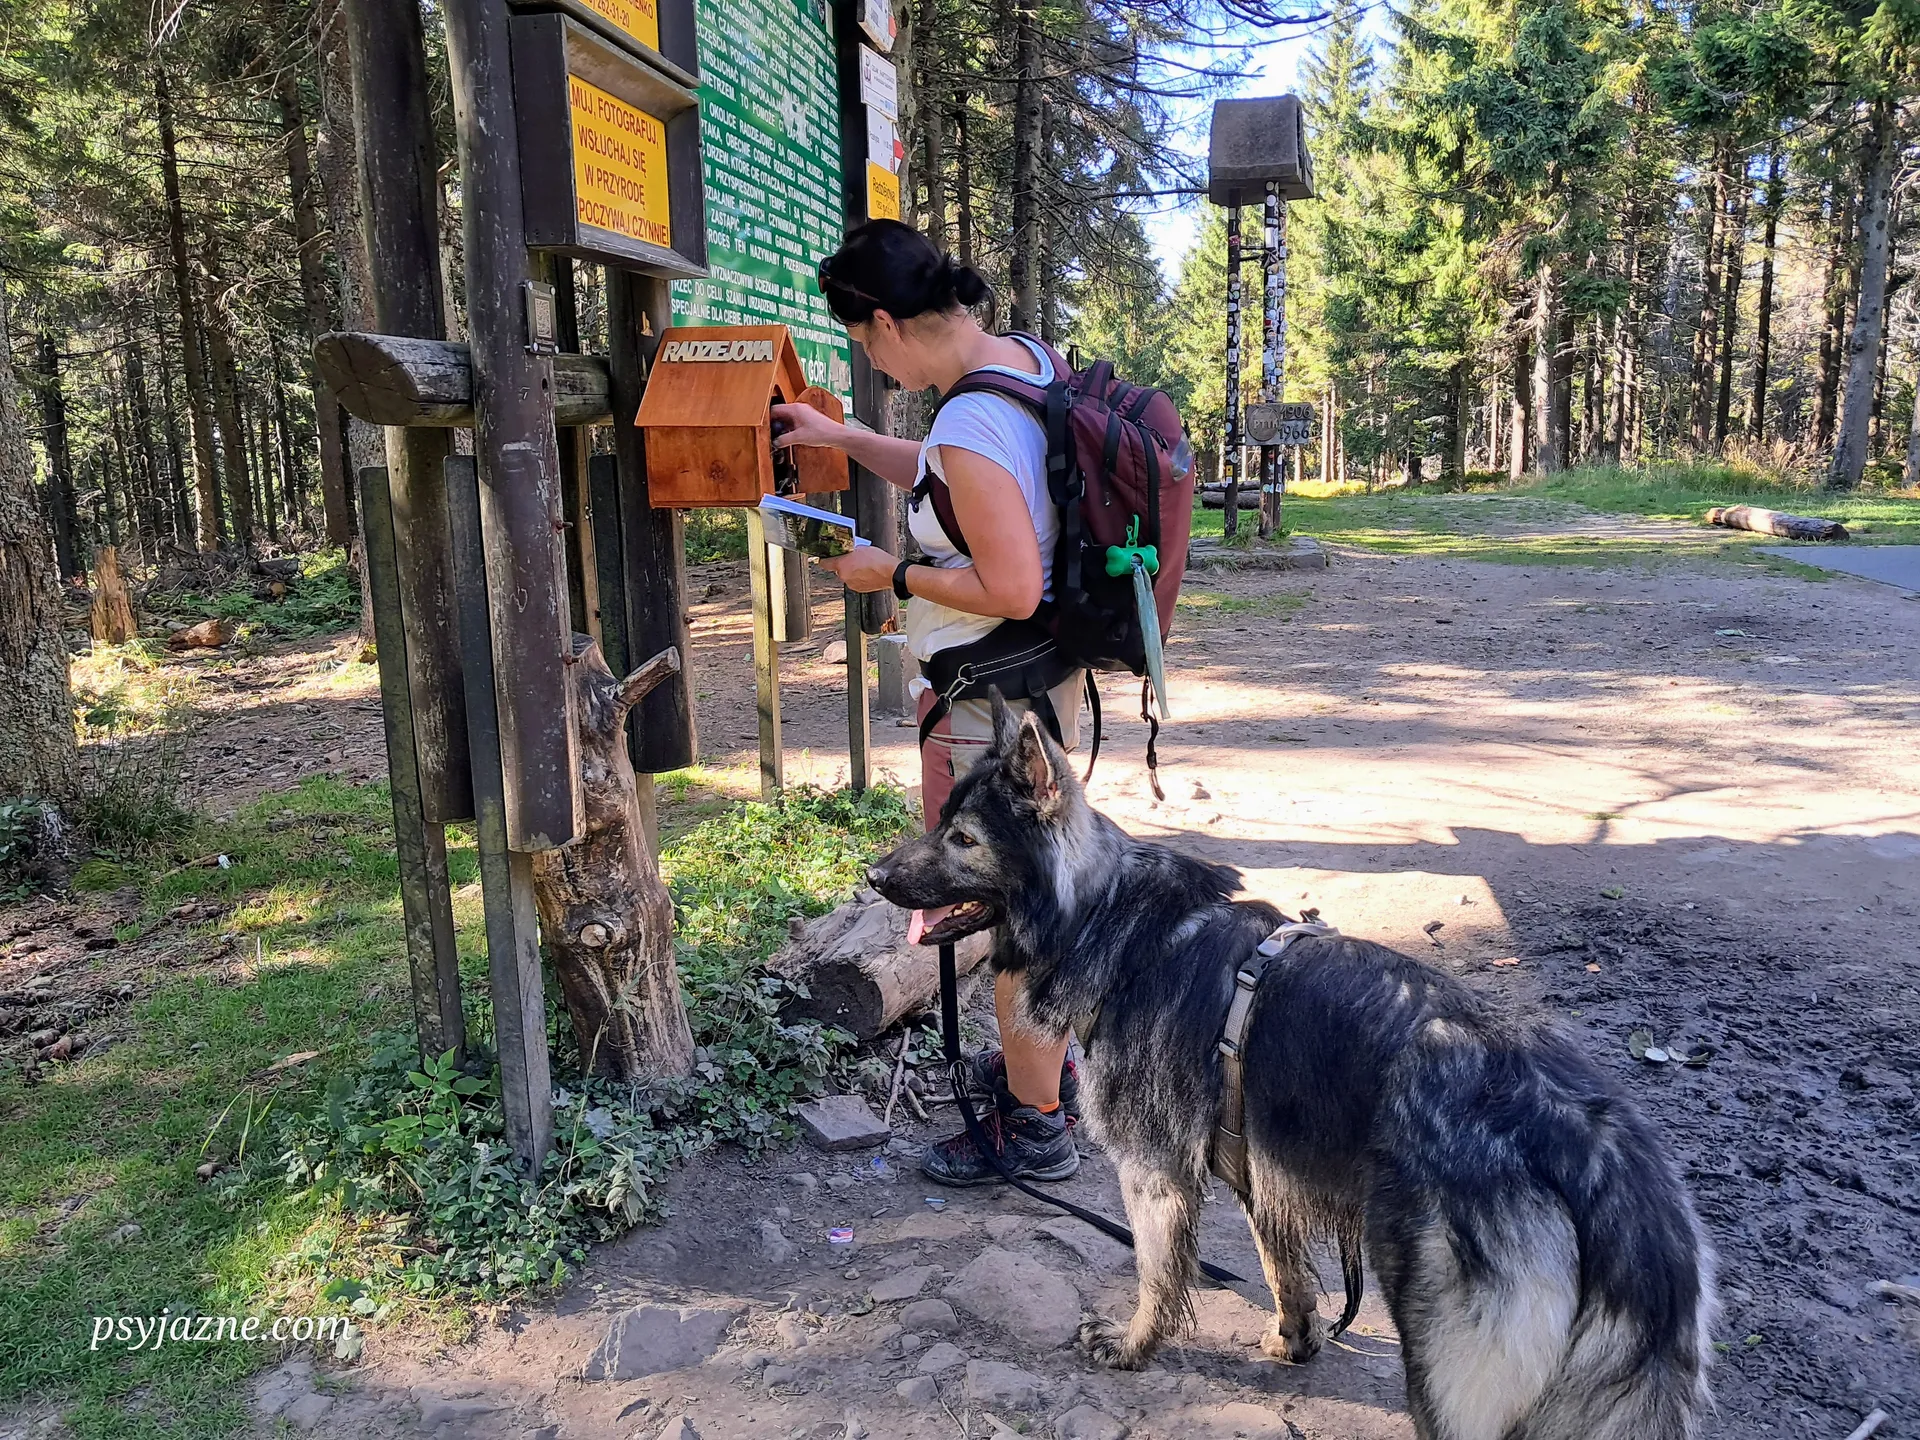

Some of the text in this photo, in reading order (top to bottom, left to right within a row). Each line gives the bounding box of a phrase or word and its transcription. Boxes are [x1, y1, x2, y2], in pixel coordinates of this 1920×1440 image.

[703, 3, 717, 27] JAK
[718, 15, 744, 48] CZARNA
[703, 46, 739, 85] WSŁUCHAĆ
[740, 72, 747, 90] W
[730, 45, 770, 87] PODPATRZYSZ
[570, 83, 659, 150] MUJ, FOTOGRAFUJ,
[709, 101, 737, 131] OKOLICE
[740, 119, 776, 154] RADZIEJOWEJ
[778, 142, 786, 162] SĄ
[740, 92, 749, 111] TO
[753, 101, 776, 128] POMOŻE
[577, 123, 647, 179] WSŁUCHAJ SIĘ
[707, 142, 731, 169] DRZEW,
[731, 155, 751, 178] KTÓRE
[751, 165, 761, 185] CIĘ
[726, 131, 751, 158] OBECNIE
[754, 147, 772, 170] CORAZ
[774, 158, 796, 183] RZADZIEJ
[583, 162, 646, 211] W PRZYRODĘ
[715, 167, 766, 205] PRZYSPIESZONYM
[769, 194, 787, 214] TEMPIE
[794, 206, 801, 224] SĄ
[577, 197, 670, 246] POCZYWAJ CZYNNIE!
[711, 208, 741, 233] ZASTĄPIĆ
[745, 222, 751, 237] JE
[739, 200, 766, 224] RÓŻNYCH
[801, 227, 821, 247] DLATEGO
[735, 238, 746, 255] TEN
[750, 243, 781, 267] NAZYWAMY
[672, 298, 710, 320] SPECJALNIE
[712, 307, 724, 323] DLA
[792, 326, 806, 340] TYLKO
[695, 282, 705, 298] DO
[707, 285, 724, 303] CELU.
[726, 290, 746, 308] SZANUJ
[748, 295, 778, 316] URZĄDZENIA
[661, 340, 773, 362] RADZIEJOWA
[1278, 425, 1310, 440] 1966
[1280, 405, 1311, 420] 1906
